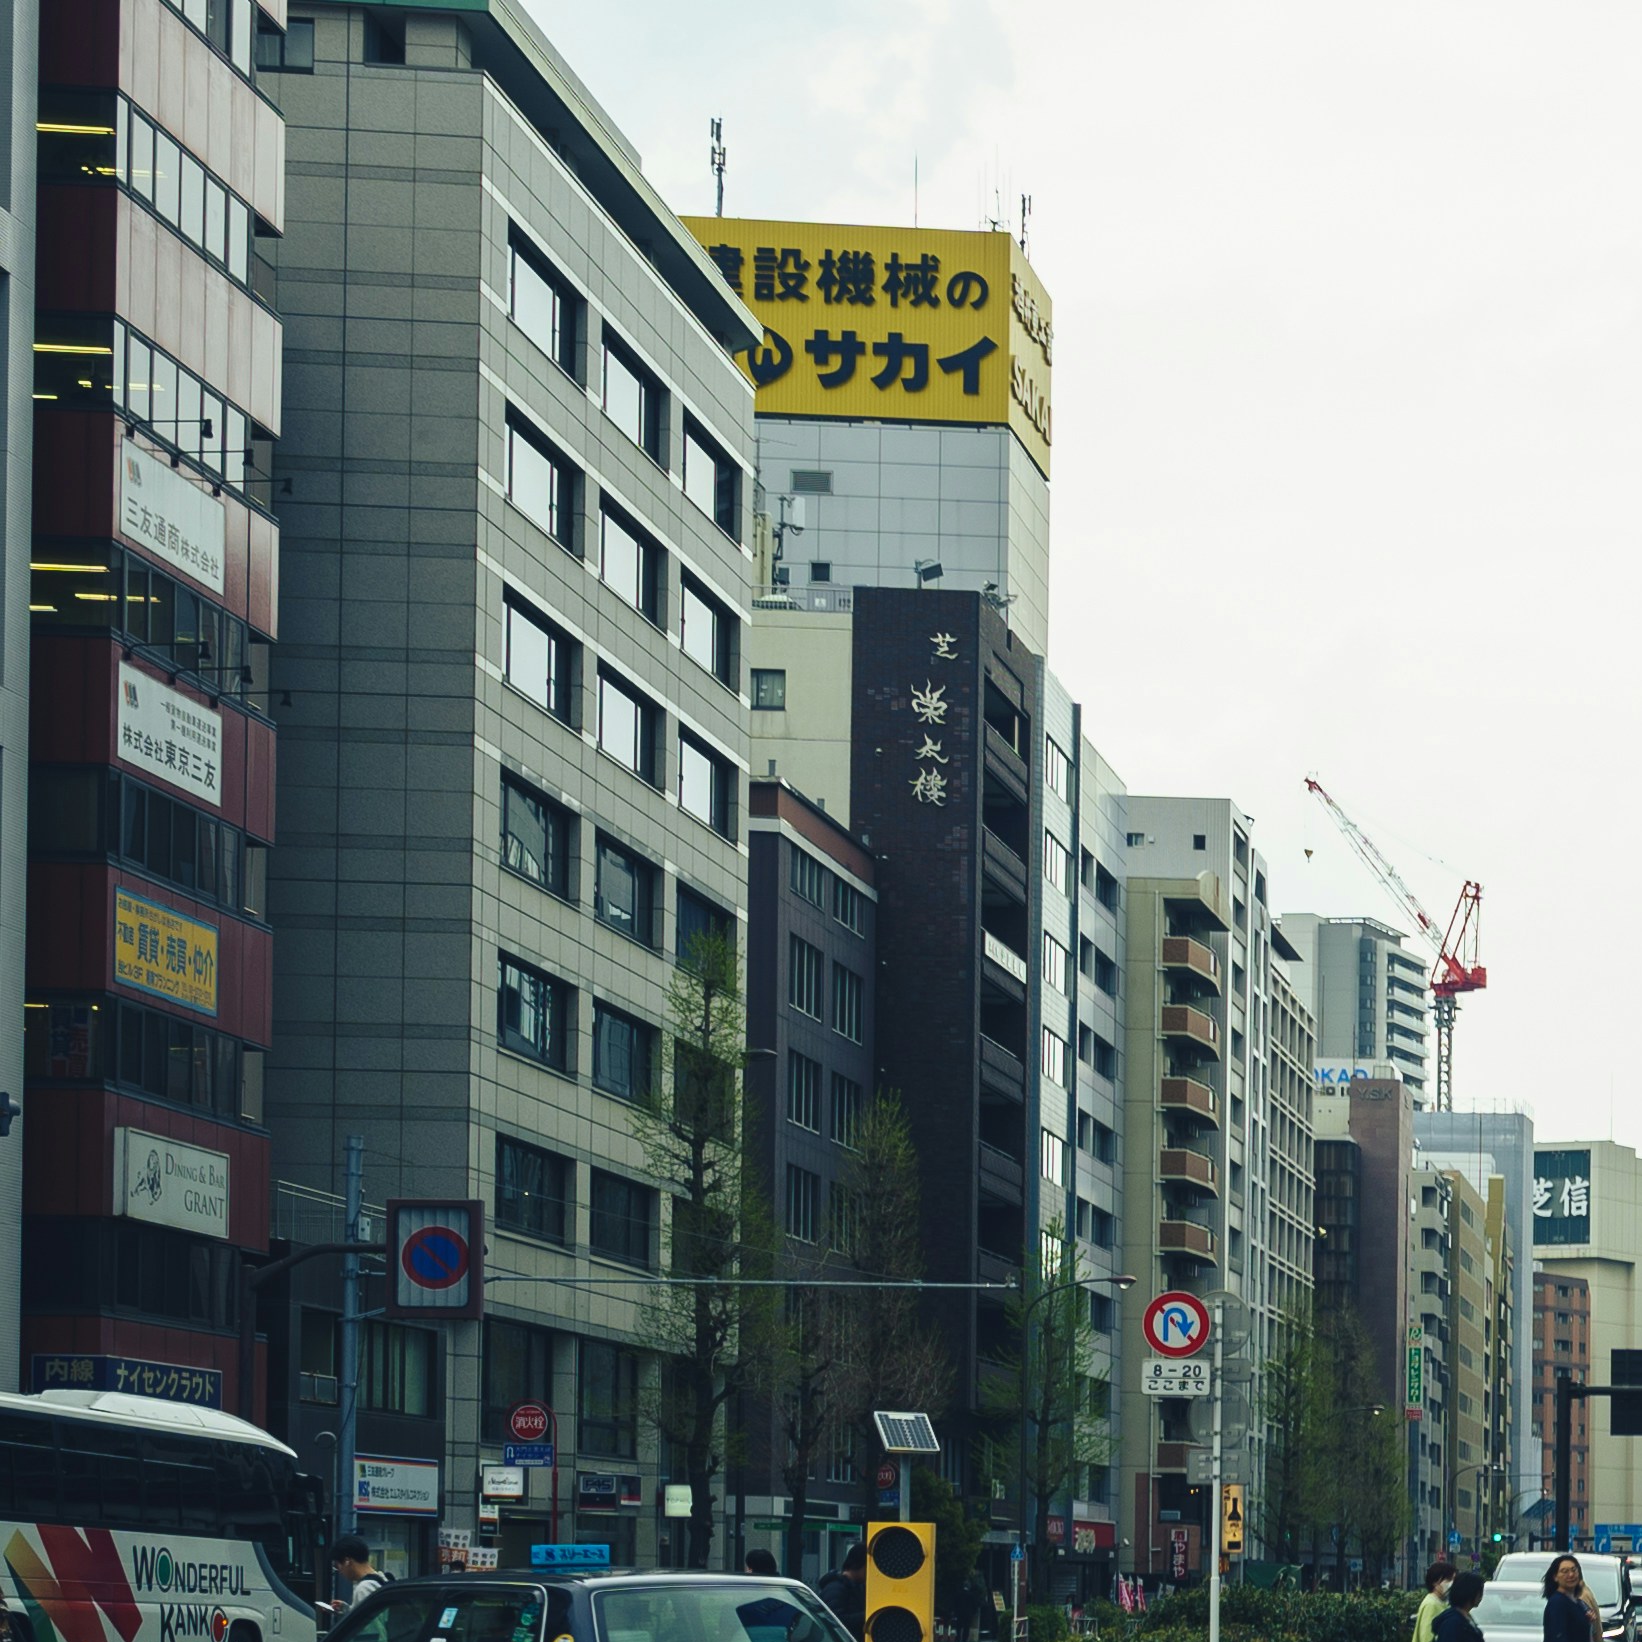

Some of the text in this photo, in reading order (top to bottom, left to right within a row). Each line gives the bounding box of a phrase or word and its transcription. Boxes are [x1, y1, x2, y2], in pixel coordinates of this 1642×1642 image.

[805, 329, 998, 394] サカイ
[126, 497, 219, 580] 三友通商株式会社
[929, 632, 959, 660] 芝
[123, 722, 216, 790] 株式会社東京三友
[184, 1190, 224, 1219] GRANT
[1533, 1175, 1590, 1218] 芝信
[45, 1358, 94, 1383] 内線
[116, 1362, 214, 1402] ナイセンクラウド
[1149, 1380, 1205, 1392] ここまで
[515, 1416, 545, 1430] 消火栓
[132, 1545, 251, 1596] WONDERFUL
